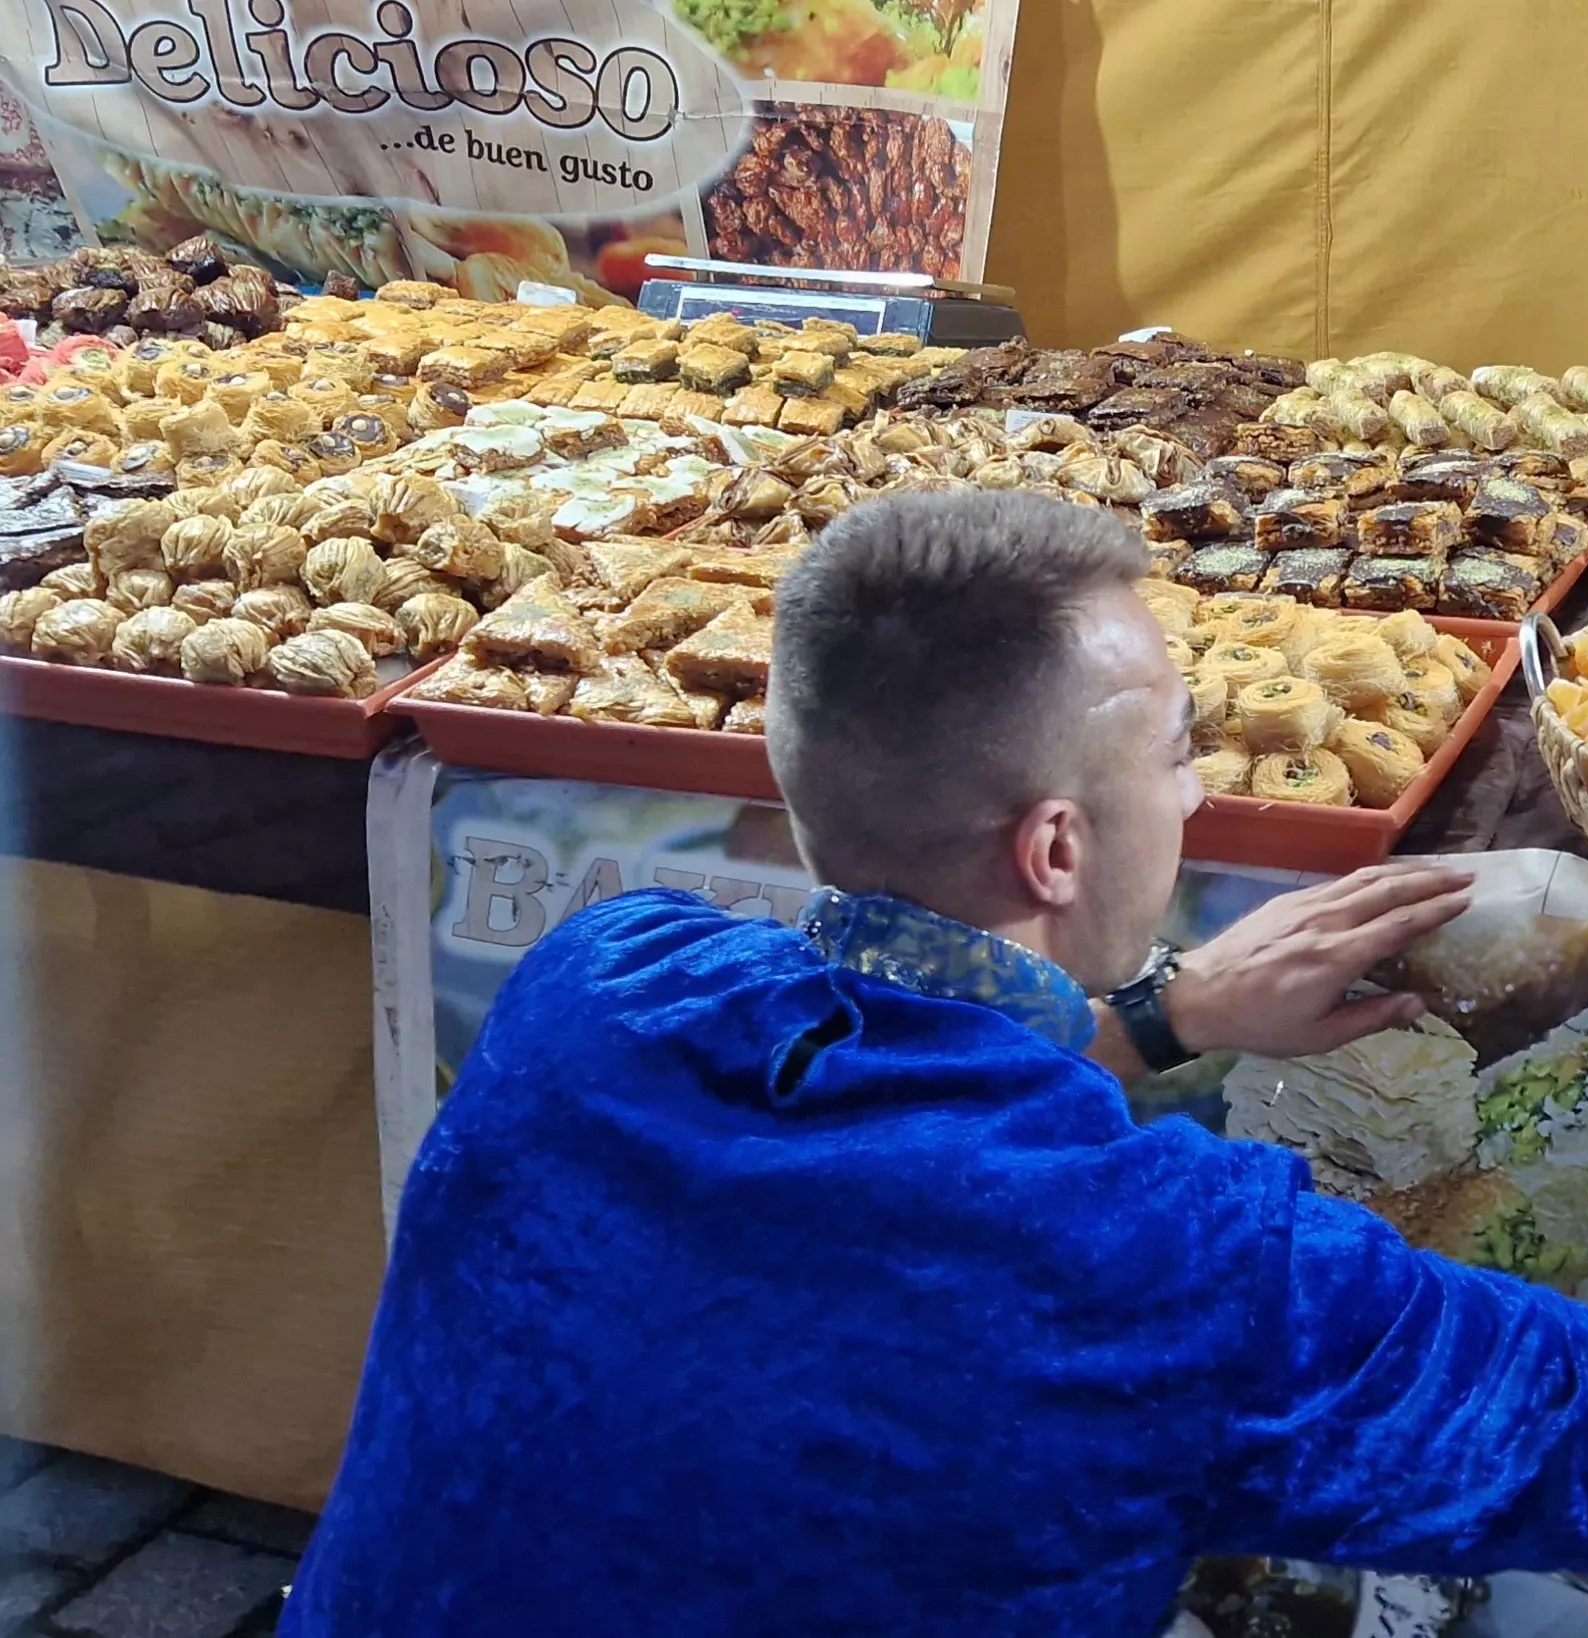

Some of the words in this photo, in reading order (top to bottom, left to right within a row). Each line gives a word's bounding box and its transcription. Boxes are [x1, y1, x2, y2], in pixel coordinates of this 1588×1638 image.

[45, 0, 680, 142] Delicioso
[467, 137, 548, 174] buen
[559, 155, 655, 193] gusto
